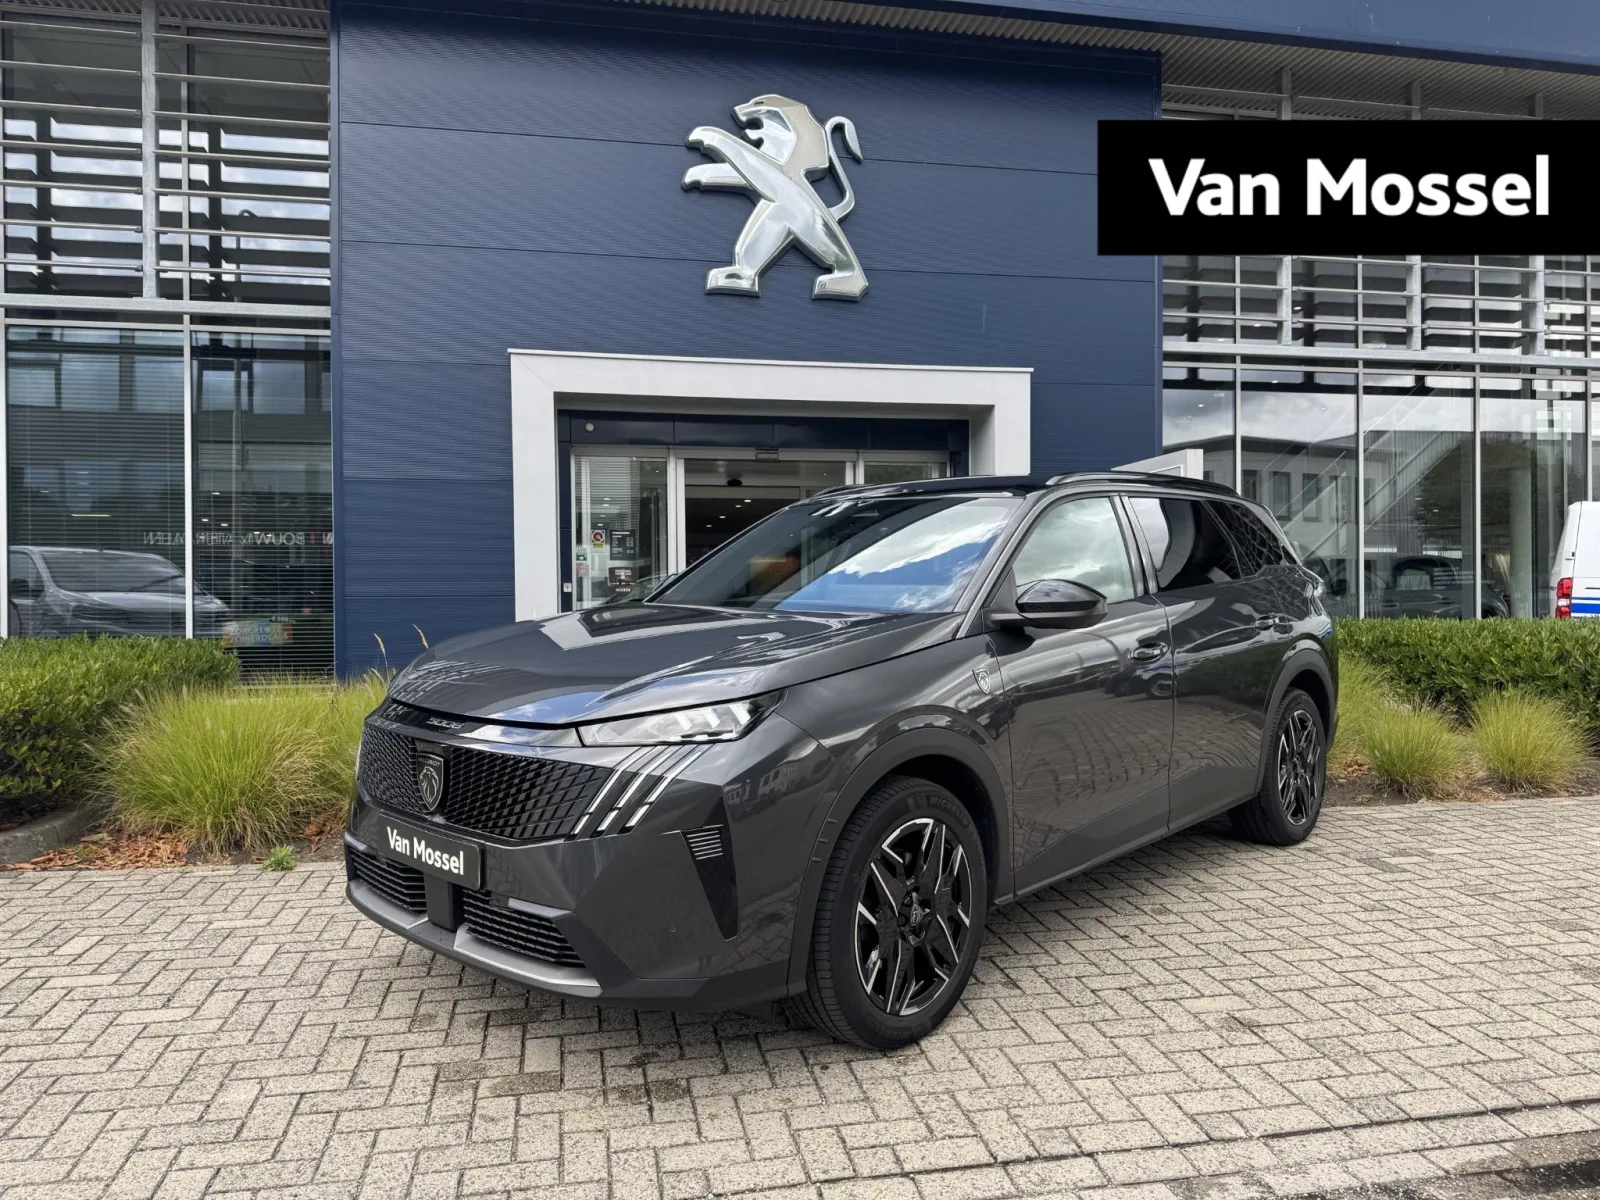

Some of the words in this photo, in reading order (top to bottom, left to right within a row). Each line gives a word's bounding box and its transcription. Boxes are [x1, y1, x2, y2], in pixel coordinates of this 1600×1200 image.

[426, 716, 465, 729] 5008
[386, 826, 410, 857] Van
[413, 837, 464, 876] Mossel
